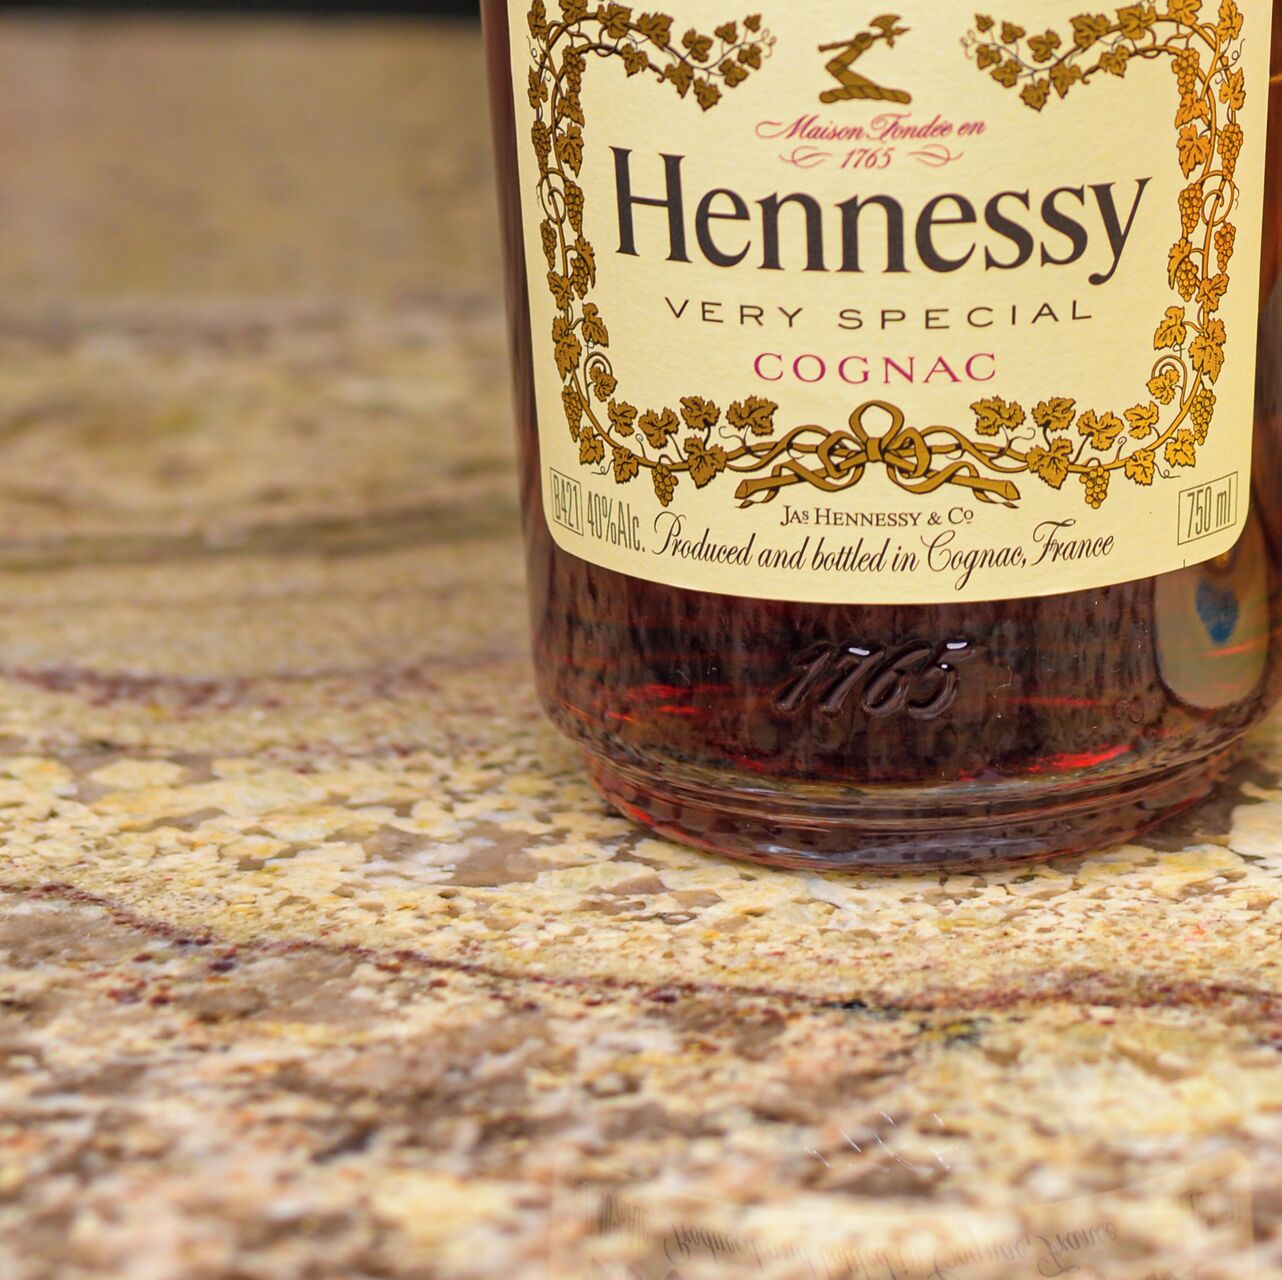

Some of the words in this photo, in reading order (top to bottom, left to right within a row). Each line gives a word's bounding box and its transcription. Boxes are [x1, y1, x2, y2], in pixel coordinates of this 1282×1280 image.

[755, 113, 864, 141] Maison
[957, 120, 987, 137] en
[839, 146, 896, 170] 1765
[608, 145, 1153, 286] Hennessy
[663, 296, 804, 329] VERY
[837, 299, 1094, 331] SPECIAL
[752, 352, 998, 386] COGNAC
[813, 506, 923, 528] HENNESSY
[926, 510, 943, 526] &
[1186, 485, 1213, 539] 750
[1216, 477, 1234, 528] ml
[651, 510, 756, 567] Produced
[757, 535, 808, 571] and
[810, 536, 890, 573] bottled
[890, 545, 920, 573] in
[919, 529, 1028, 591] Cognac,
[1029, 518, 1115, 567] France
[772, 640, 978, 722] 1765
